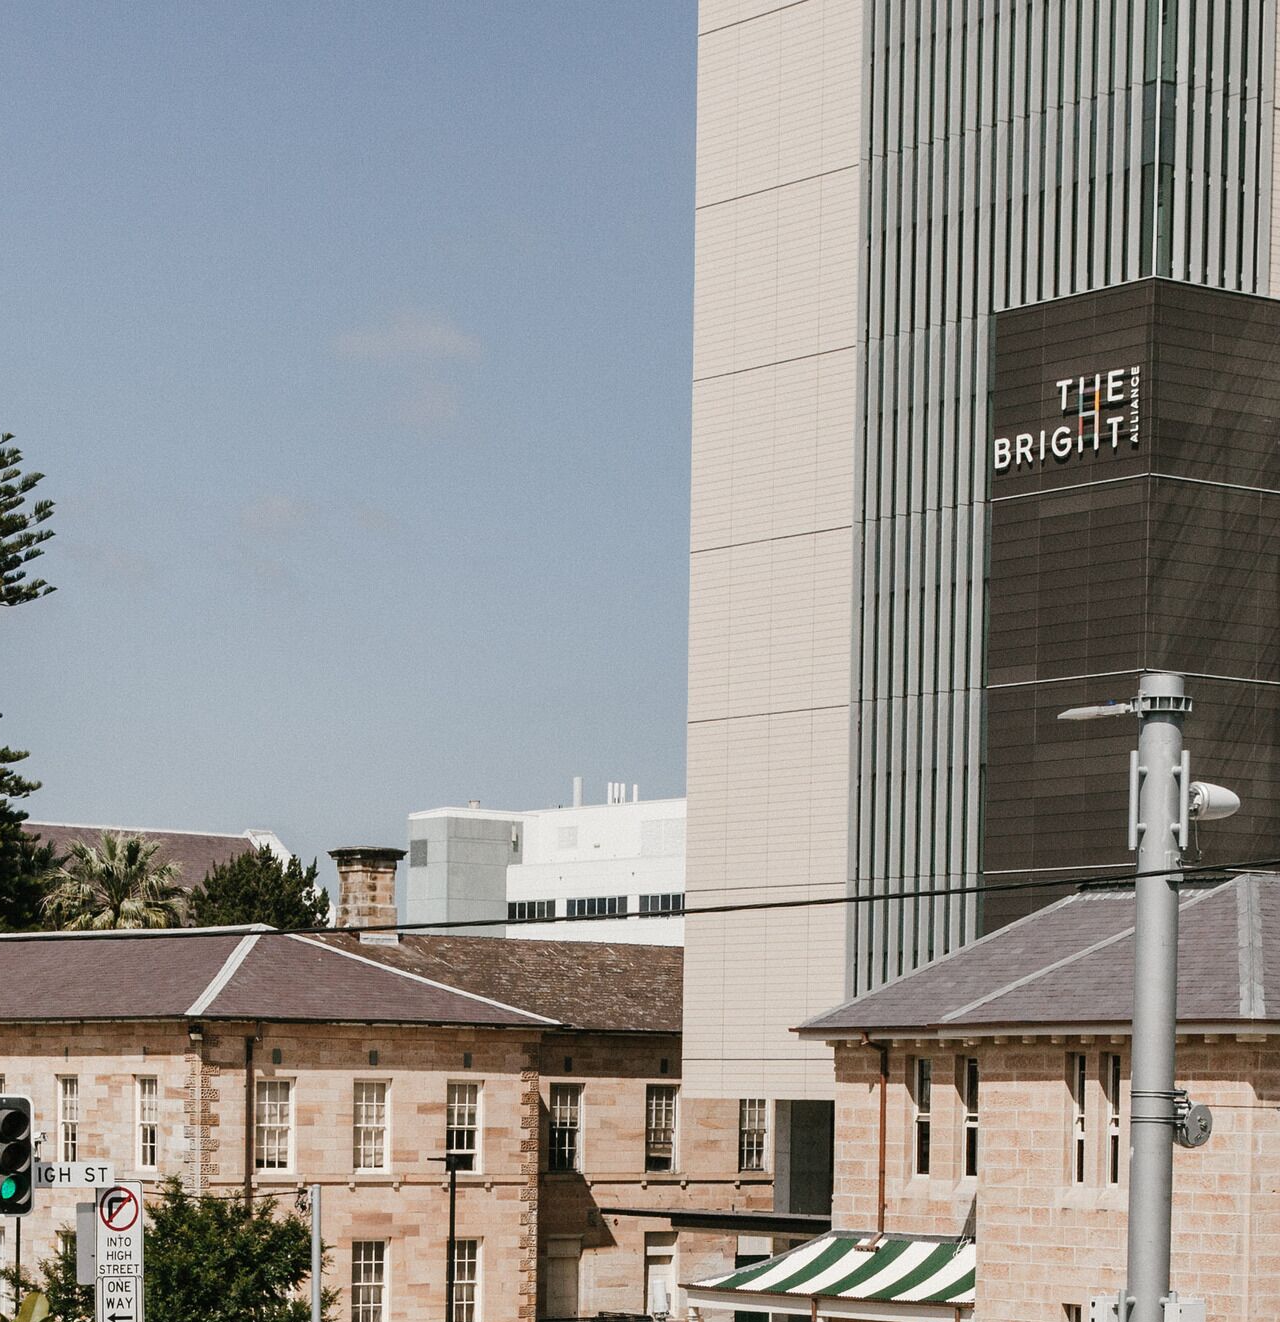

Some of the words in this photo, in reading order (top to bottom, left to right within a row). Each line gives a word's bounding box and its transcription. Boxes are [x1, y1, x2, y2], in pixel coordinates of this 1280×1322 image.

[1056, 369, 1125, 416] THE
[1129, 365, 1140, 443] ALLIANCE
[994, 416, 1124, 470] BRIGHT
[37, 1167, 71, 1183] IGH
[84, 1167, 108, 1183] ST
[106, 1237, 132, 1247] INTO
[106, 1251, 132, 1261] HIGH
[99, 1264, 140, 1275] STREET
[108, 1281, 131, 1293] ONE
[106, 1297, 133, 1309] WAY
